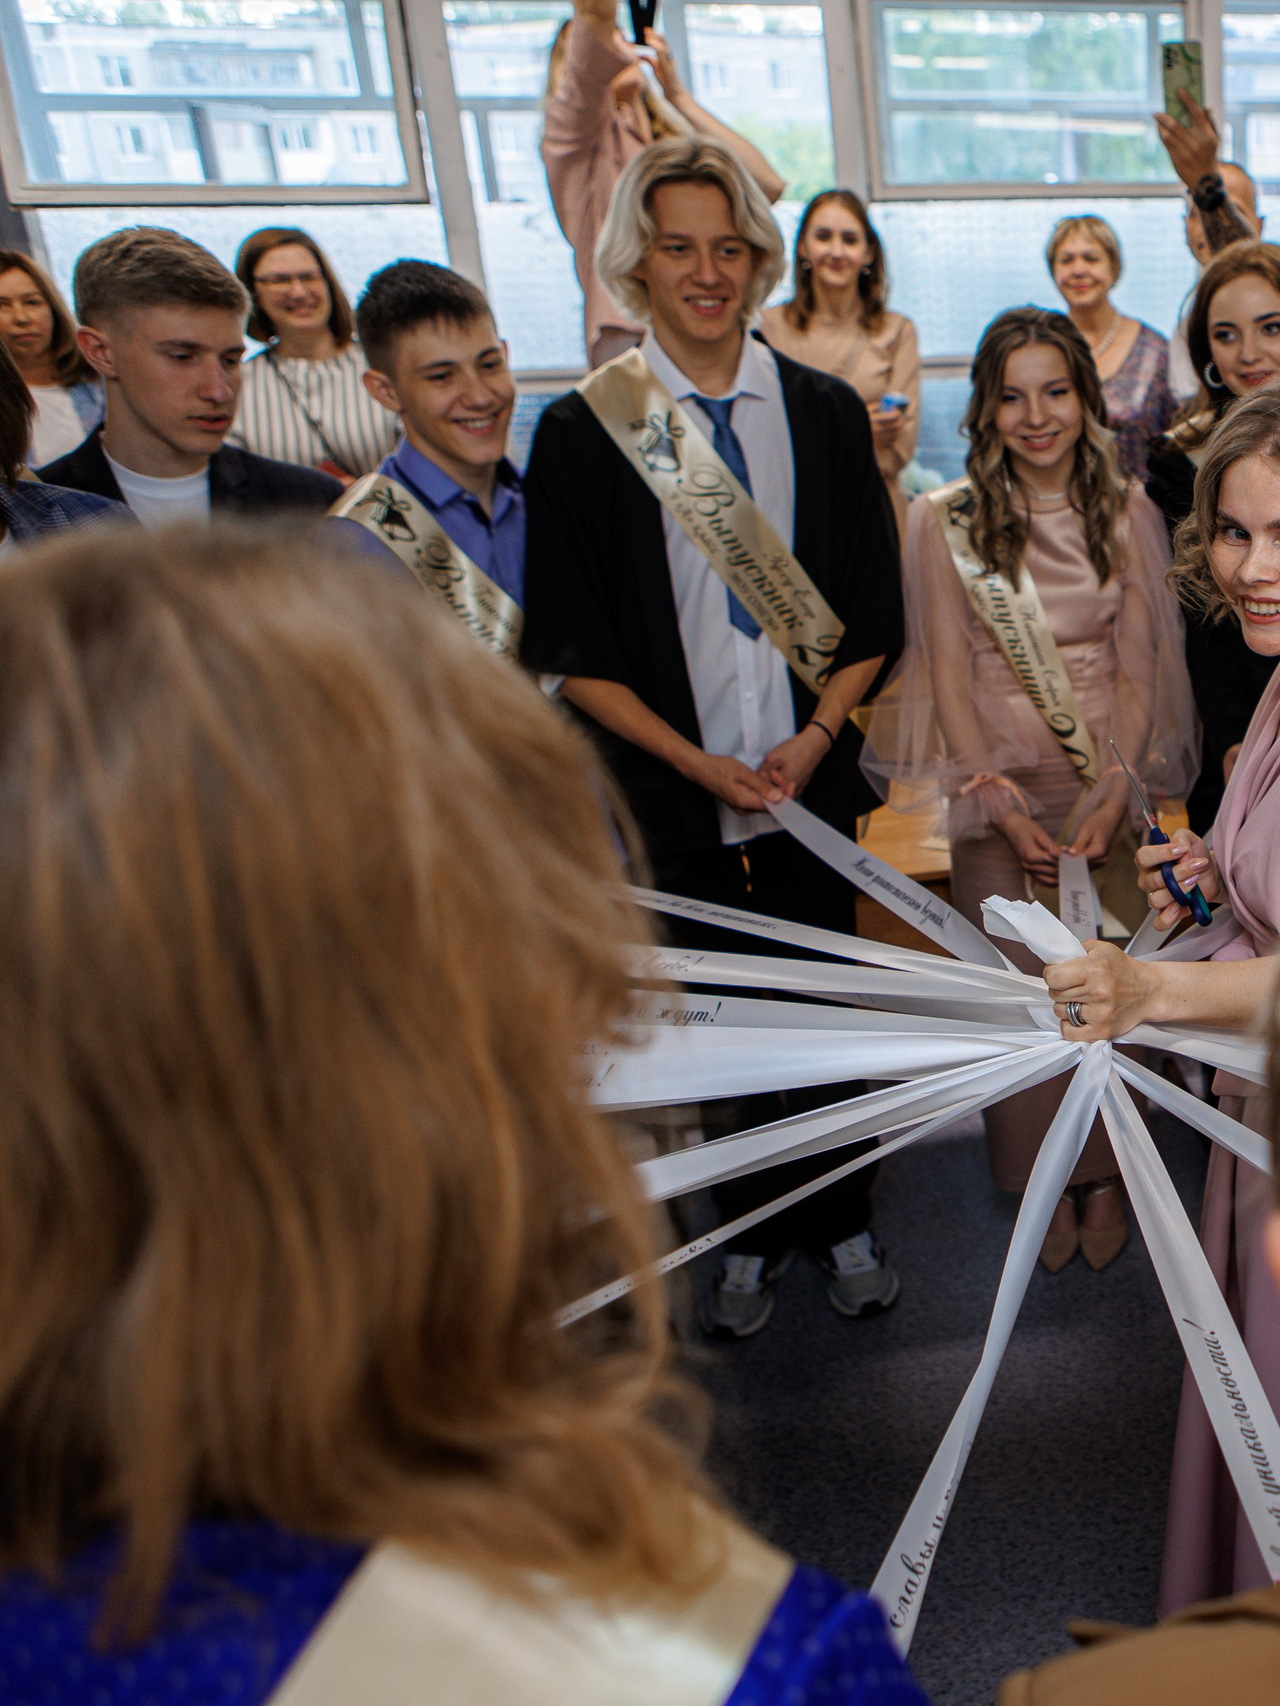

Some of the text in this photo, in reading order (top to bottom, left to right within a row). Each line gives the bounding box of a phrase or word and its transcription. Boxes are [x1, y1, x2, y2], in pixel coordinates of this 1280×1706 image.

[677, 464, 803, 630] Выпускник
[984, 575, 1046, 710] ыпускница
[889, 1537, 938, 1629] славы
